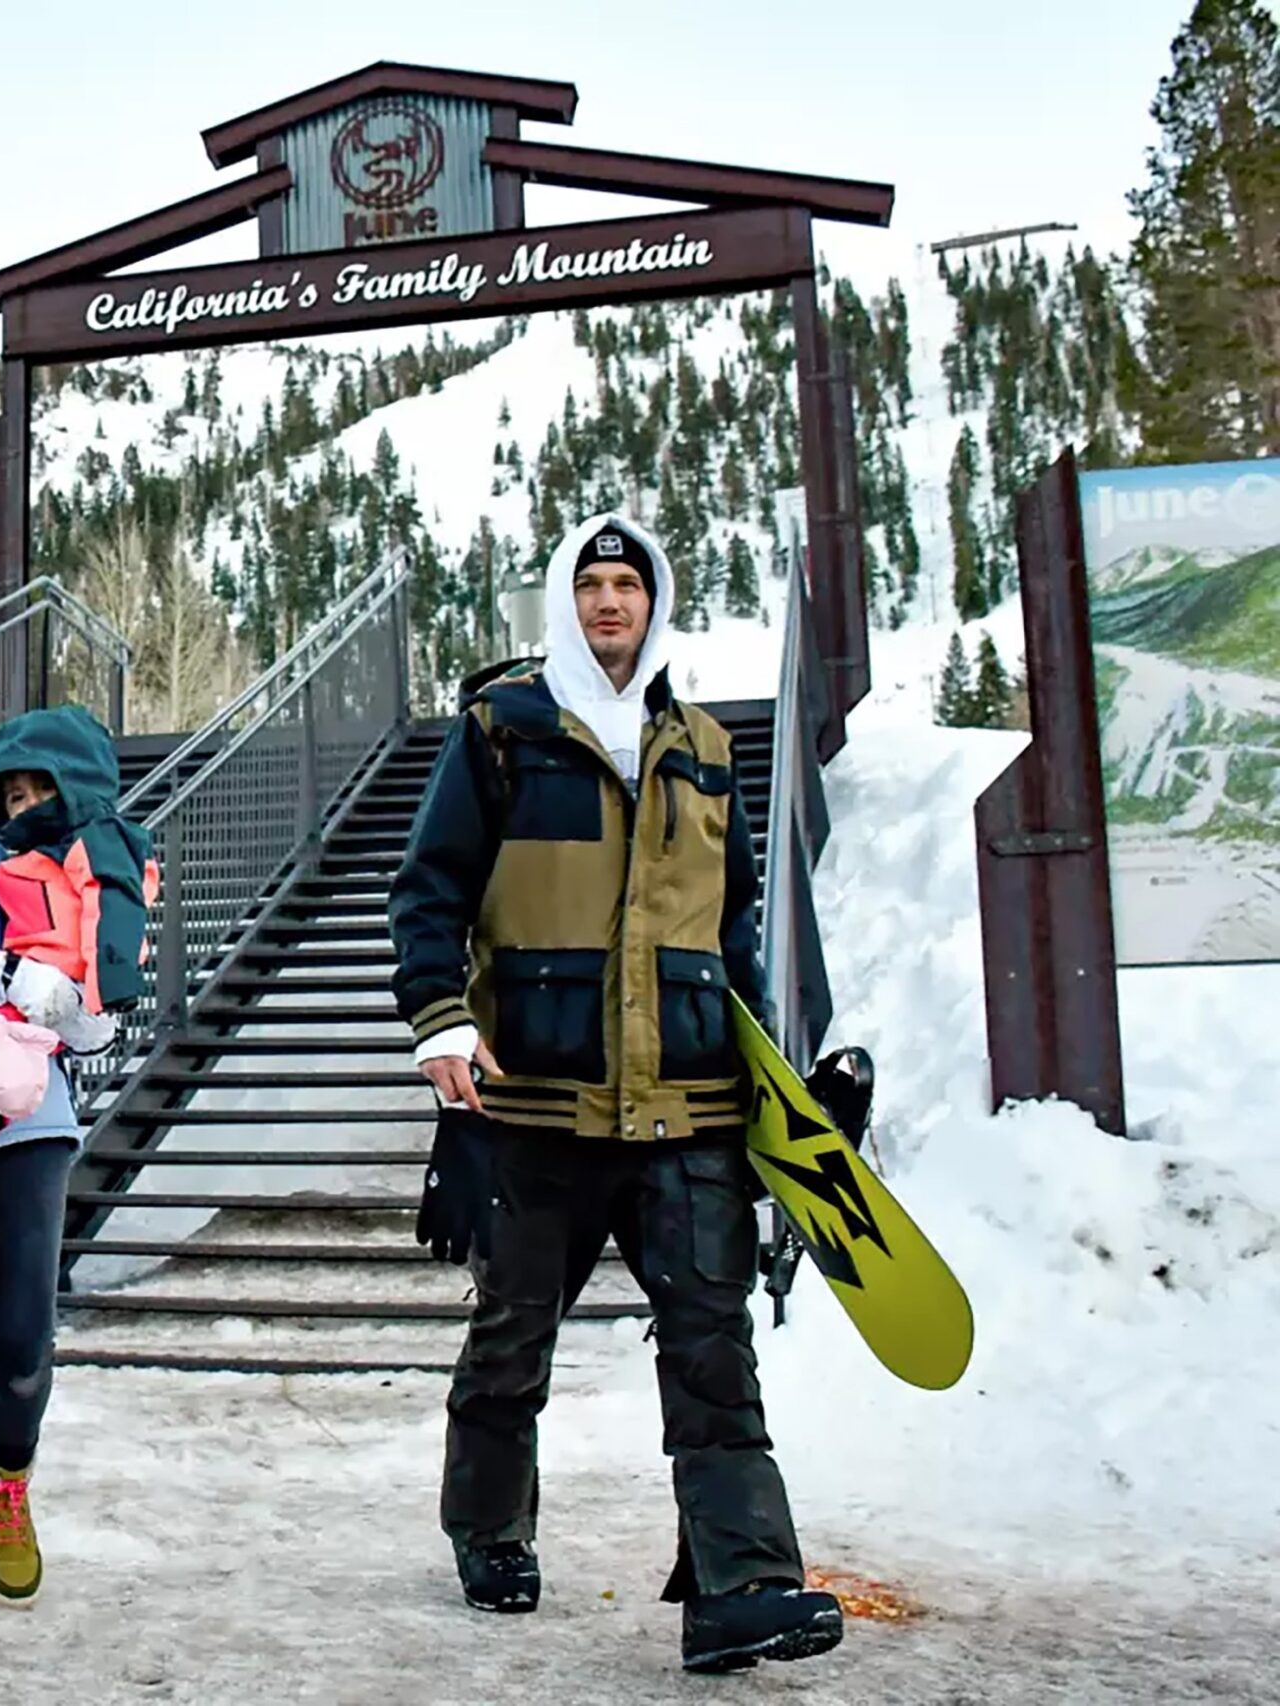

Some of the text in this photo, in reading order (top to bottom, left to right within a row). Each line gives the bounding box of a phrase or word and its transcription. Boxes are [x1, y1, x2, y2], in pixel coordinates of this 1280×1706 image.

[86, 232, 713, 334] California's Family Mountain
